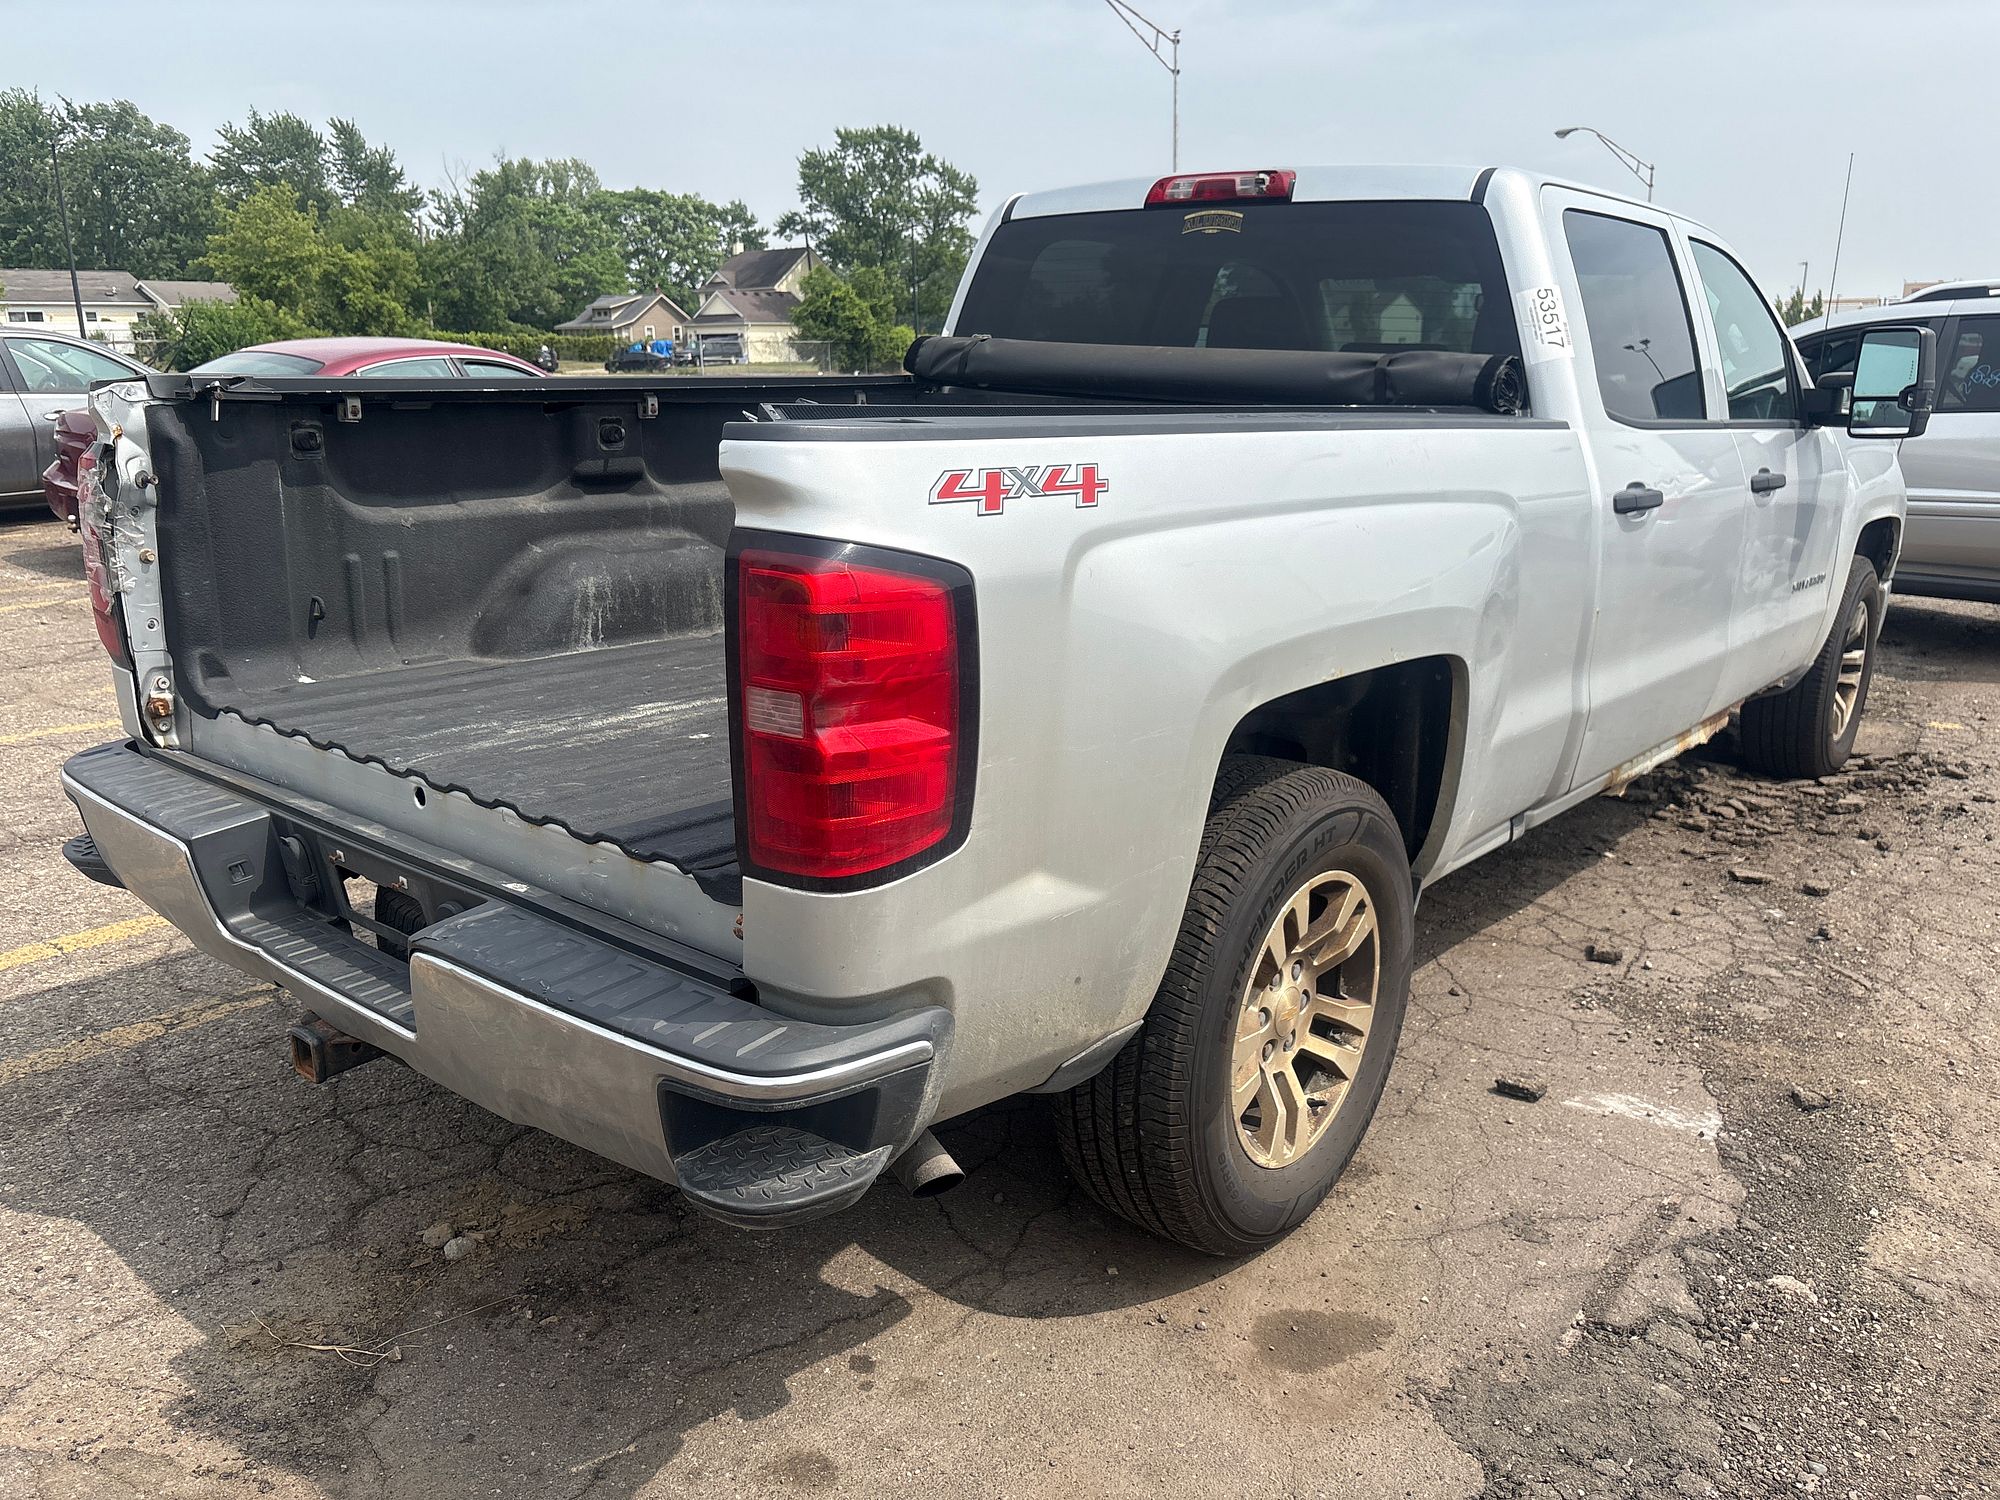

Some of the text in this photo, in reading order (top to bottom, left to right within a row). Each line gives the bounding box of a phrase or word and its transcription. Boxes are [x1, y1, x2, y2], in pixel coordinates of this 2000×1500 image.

[1183, 213, 1243, 231] ALUMNI
[1537, 288, 1565, 348] 53517
[1220, 825, 1337, 1044] PATHFINDER HT
